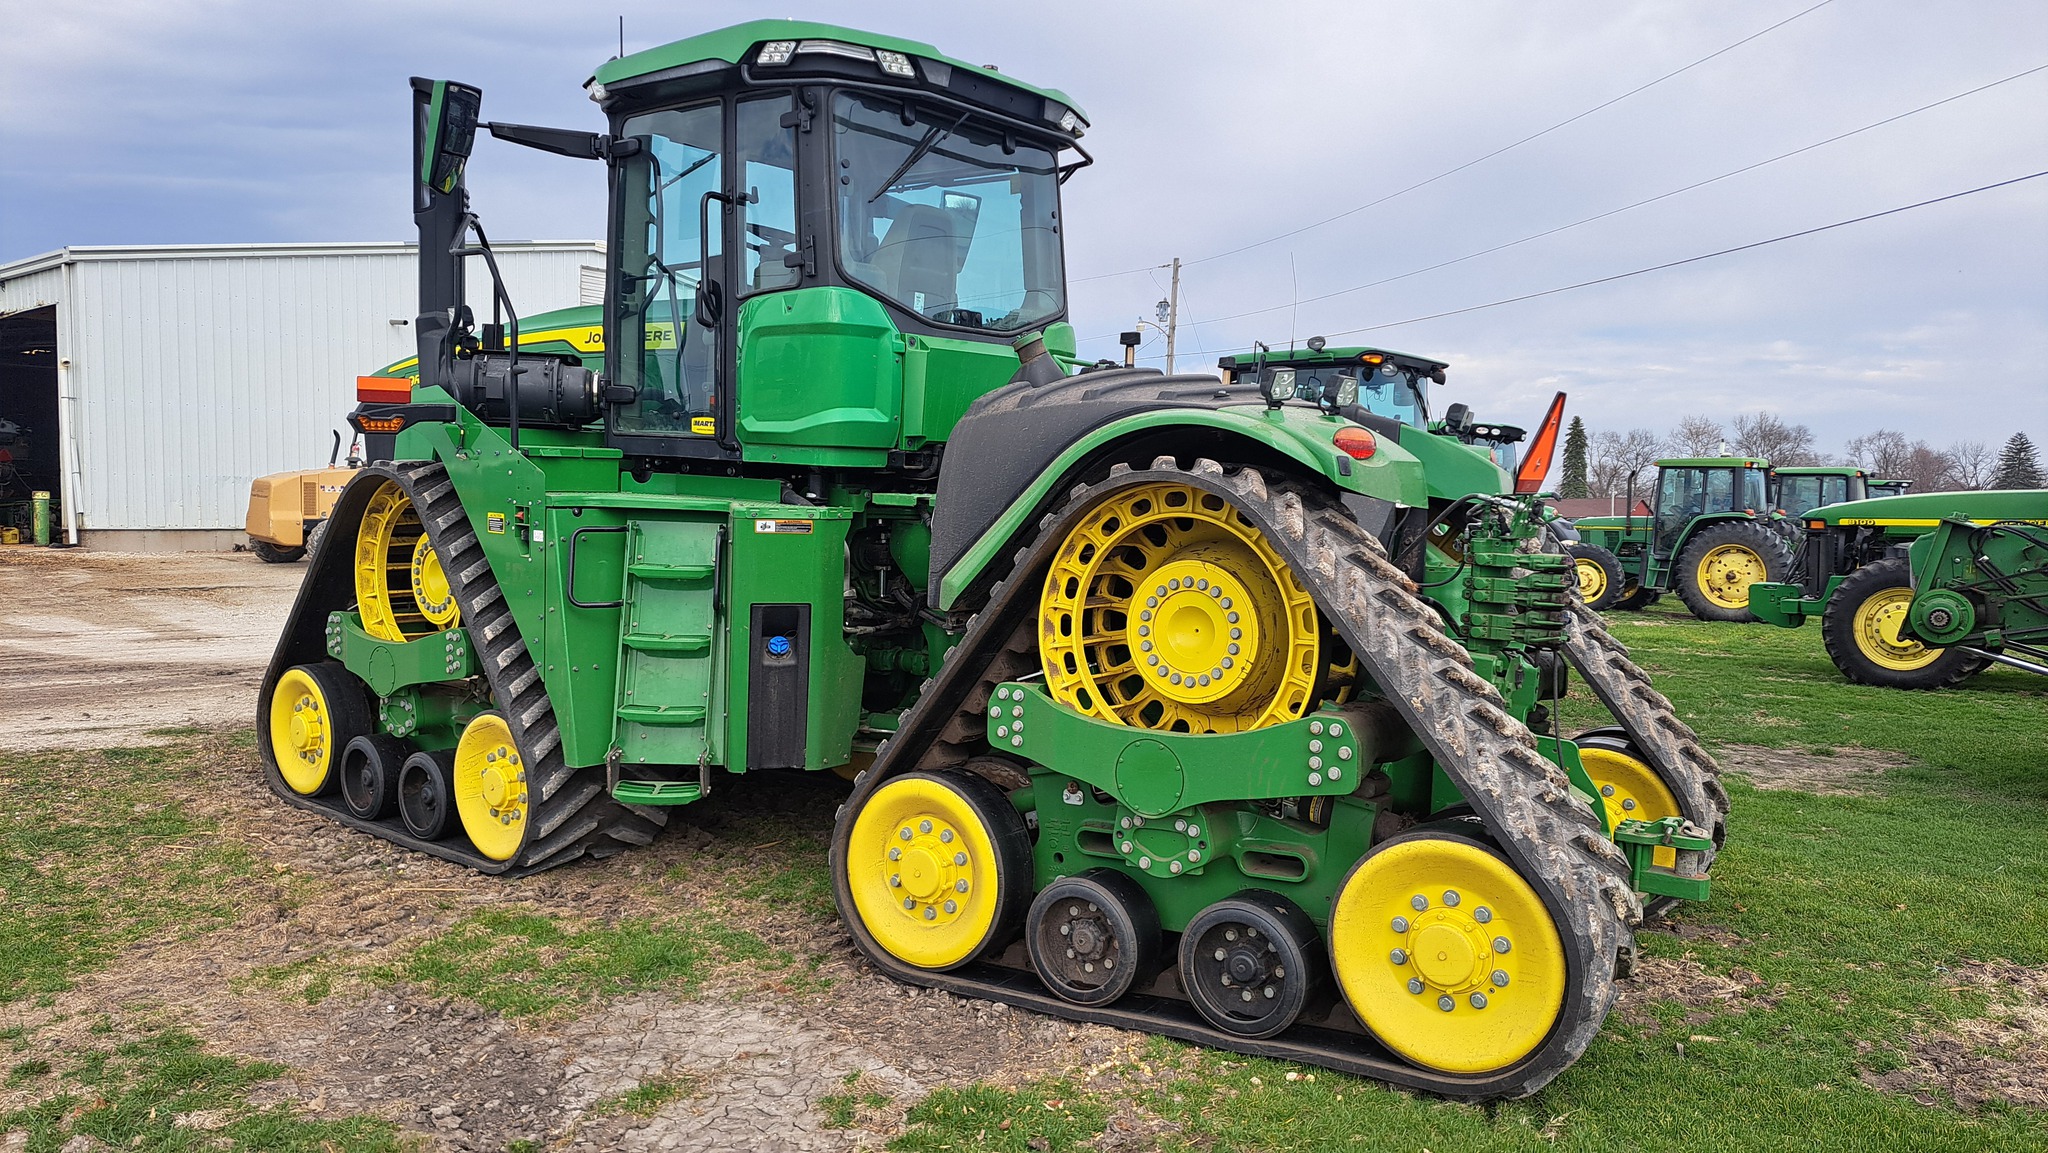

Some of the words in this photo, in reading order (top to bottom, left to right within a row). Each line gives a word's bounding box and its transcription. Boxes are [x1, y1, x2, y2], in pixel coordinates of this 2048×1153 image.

[585, 331, 604, 344] JO
[645, 330, 672, 341] ERE
[409, 374, 420, 387] 9R
